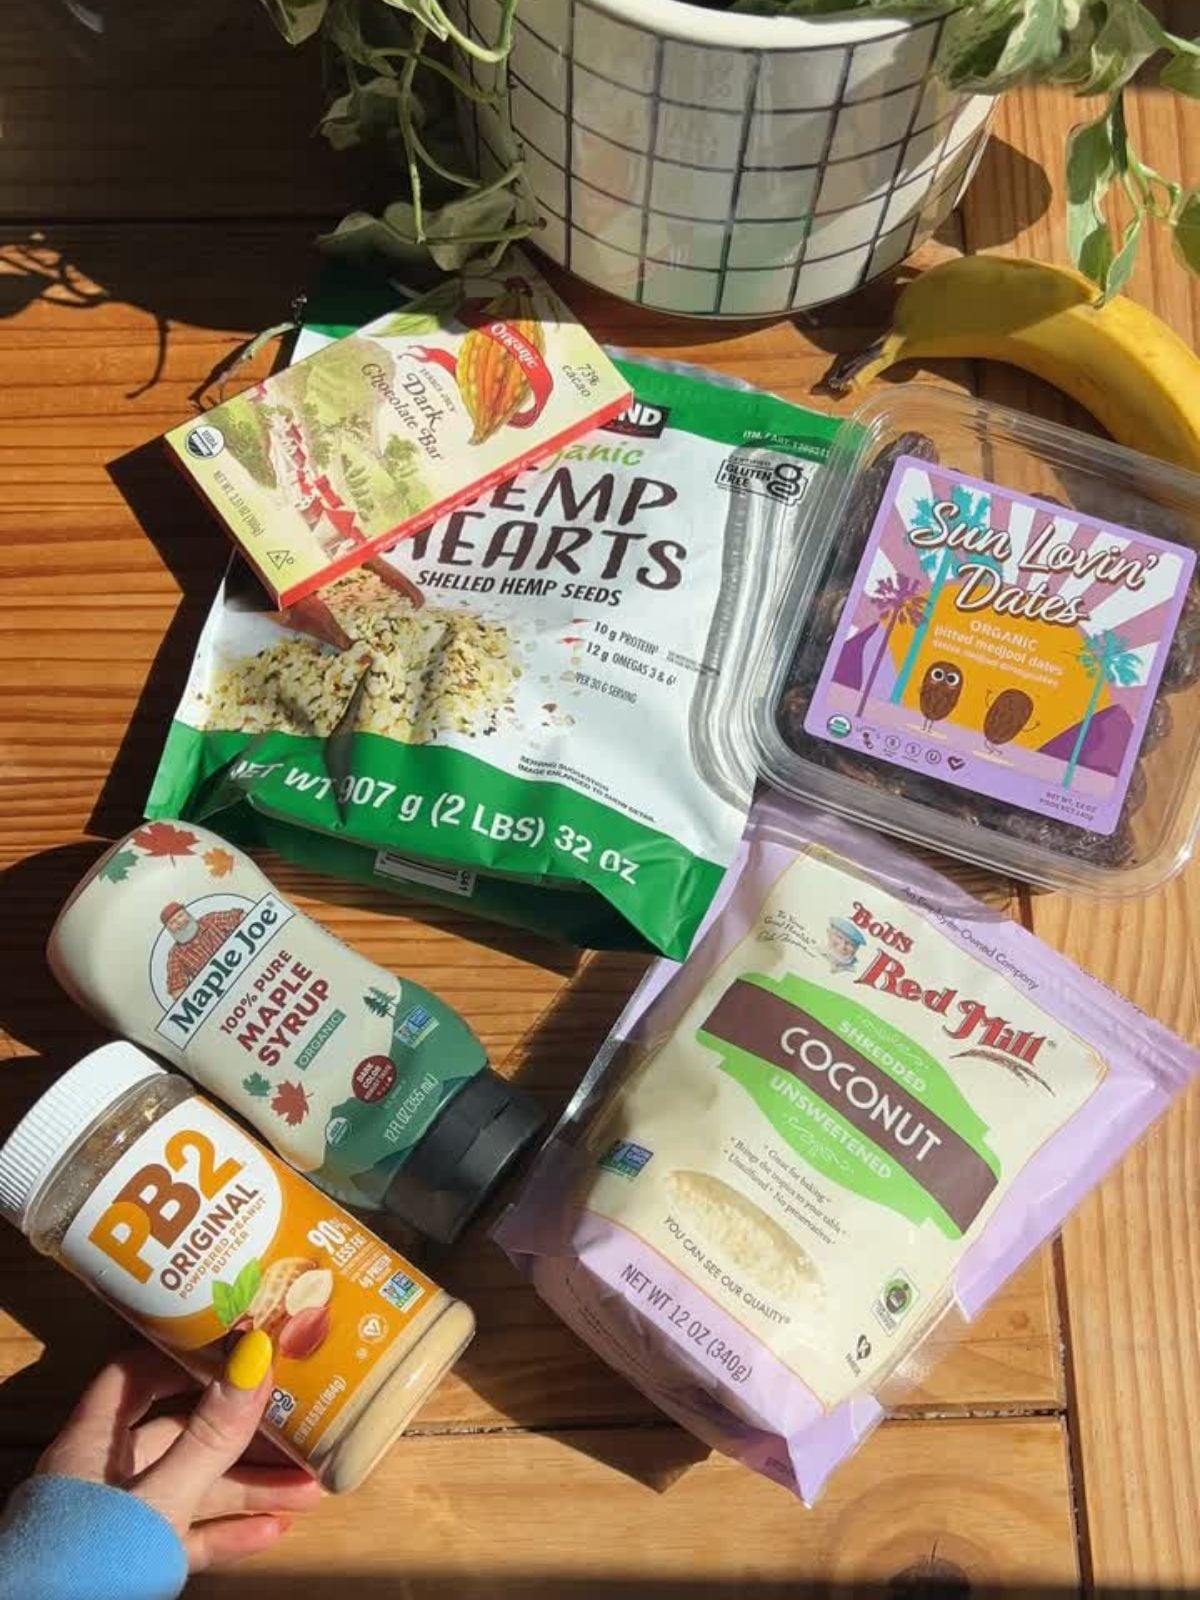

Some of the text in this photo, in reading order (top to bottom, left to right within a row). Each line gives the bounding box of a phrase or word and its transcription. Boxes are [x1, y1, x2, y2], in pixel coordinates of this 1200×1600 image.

[491, 323, 538, 368] Organic
[578, 363, 599, 386] 73%
[402, 373, 444, 432] Dark
[562, 365, 591, 397] cacao
[360, 363, 442, 459] Chocolate Bar
[460, 466, 677, 526] EMP
[721, 472, 750, 488] FREE
[723, 463, 772, 481] GLUTEN
[908, 500, 1159, 589] Sun Lovin'
[417, 569, 622, 606] SHELLED HEMP SEEDS
[955, 560, 1091, 627] Dates
[595, 621, 608, 634] 10
[608, 630, 617, 641] g
[934, 625, 974, 645] pitted
[975, 639, 1027, 664] medjool
[1028, 657, 1062, 676] dates
[970, 620, 1038, 651] ORGANIC
[586, 642, 601, 656] 12
[600, 651, 609, 662] g
[612, 652, 649, 675] OMEGAS
[648, 667, 656, 678] 3
[657, 671, 664, 681] &
[590, 678, 601, 690] 30
[608, 684, 637, 703] SERVING
[230, 760, 640, 886] NET WT 907 g (2 LBS) 32 OZ
[168, 950, 242, 1034] Maple
[220, 950, 292, 1034] 100% PURE
[853, 948, 959, 1016] Red
[993, 953, 1040, 991] Company
[236, 962, 312, 1052] MAPLE
[258, 979, 328, 1067] SYRUP
[299, 1012, 344, 1067] ORGANIC
[839, 1021, 926, 1092] SHREDDED
[362, 1065, 382, 1089] COLOR
[781, 1027, 942, 1161] COCONUT
[384, 1128, 399, 1142] 12
[403, 1088, 425, 1113] (355
[772, 1077, 892, 1178] UNSWEETENED
[88, 1130, 243, 1284] PB2
[759, 1161, 772, 1174] the
[796, 1192, 805, 1203] to
[803, 1200, 823, 1218] your
[773, 1191, 786, 1206] No
[160, 1184, 259, 1291] ORIGINAL
[178, 1197, 266, 1299] POWDERED PEANUT
[211, 1231, 248, 1274] BUTTER
[331, 1243, 356, 1267] LESS
[664, 1215, 686, 1240] YOU
[683, 1238, 705, 1262] CAN
[703, 1260, 722, 1279] SEE
[721, 1275, 743, 1296] OUR
[621, 1264, 752, 1384] NET WT 12 OZ (340g)
